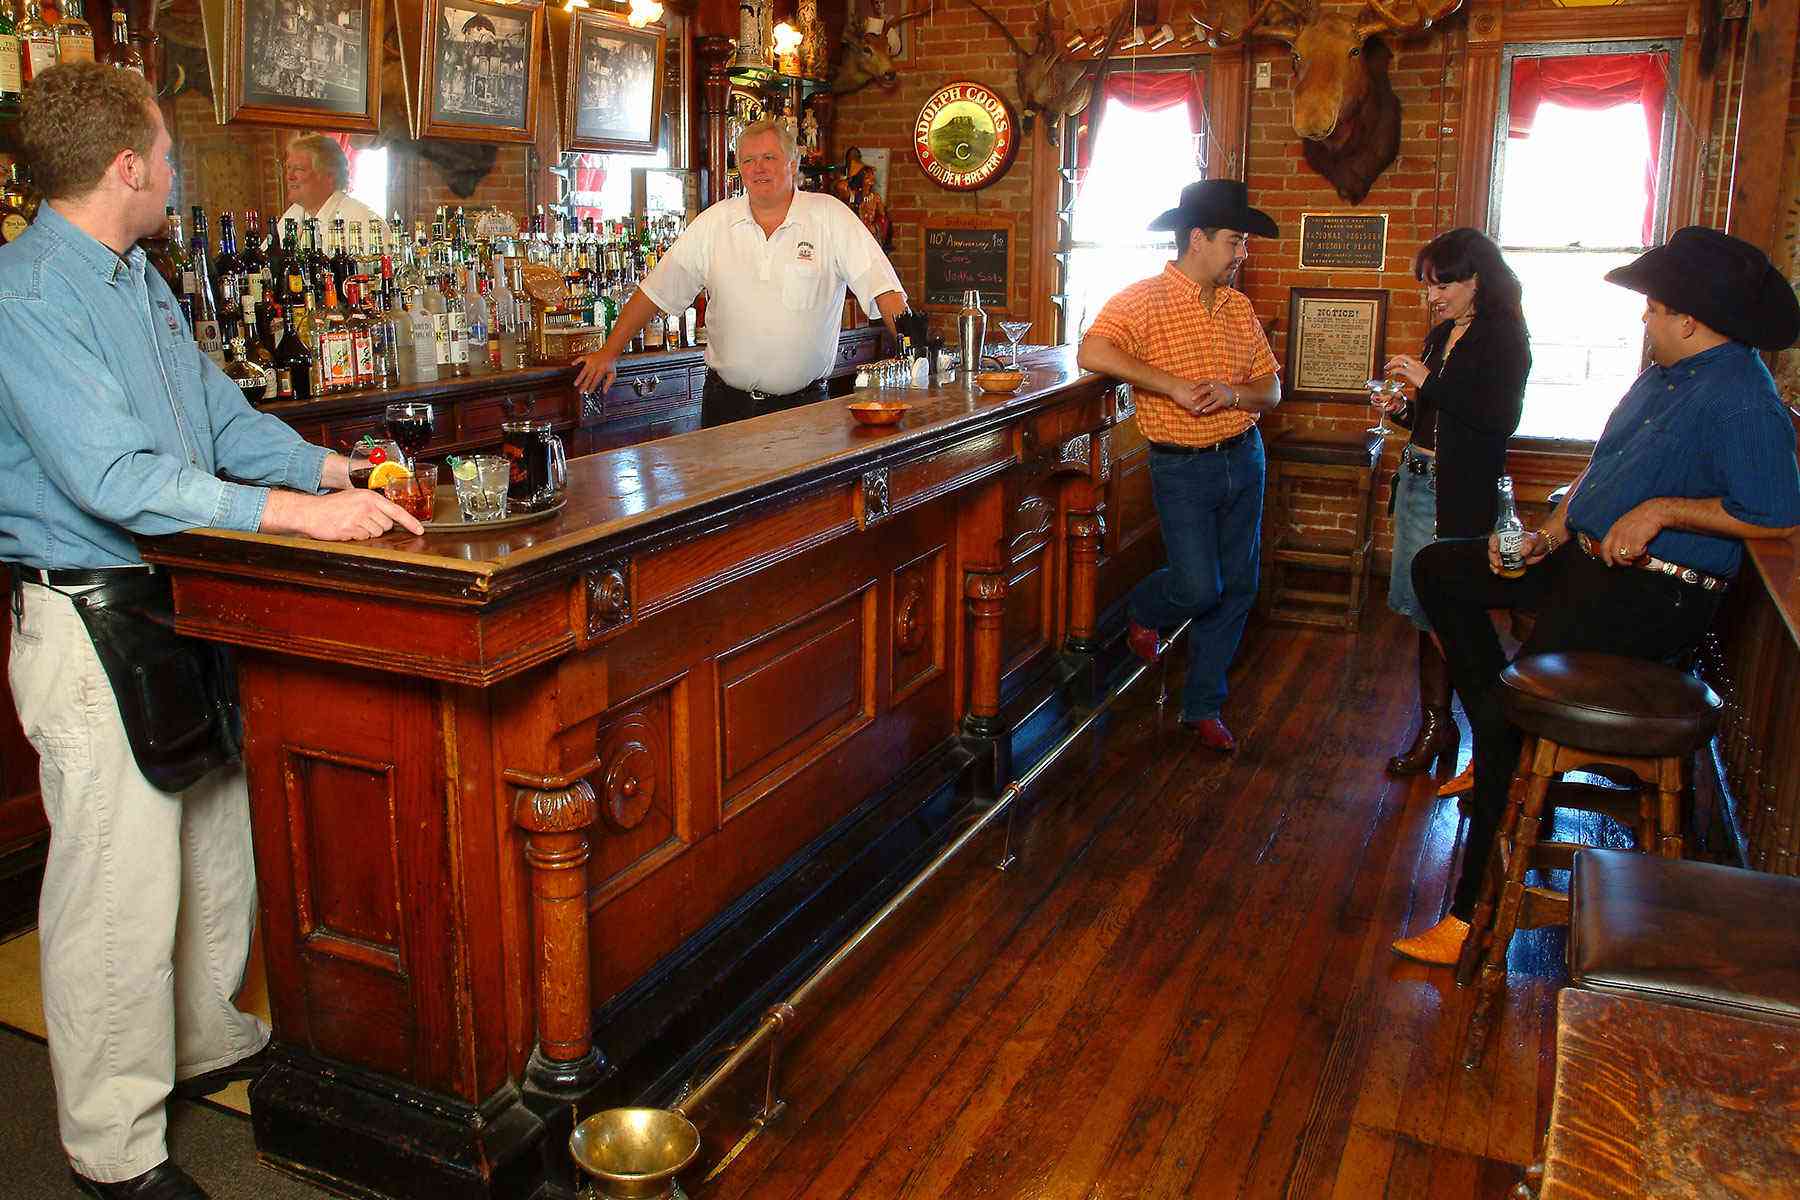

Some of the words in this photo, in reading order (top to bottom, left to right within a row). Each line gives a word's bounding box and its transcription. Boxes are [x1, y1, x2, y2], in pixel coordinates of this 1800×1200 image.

[917, 88, 961, 145] ADOLPH
[966, 87, 1008, 132] COORS
[927, 161, 961, 186] GOLDEN
